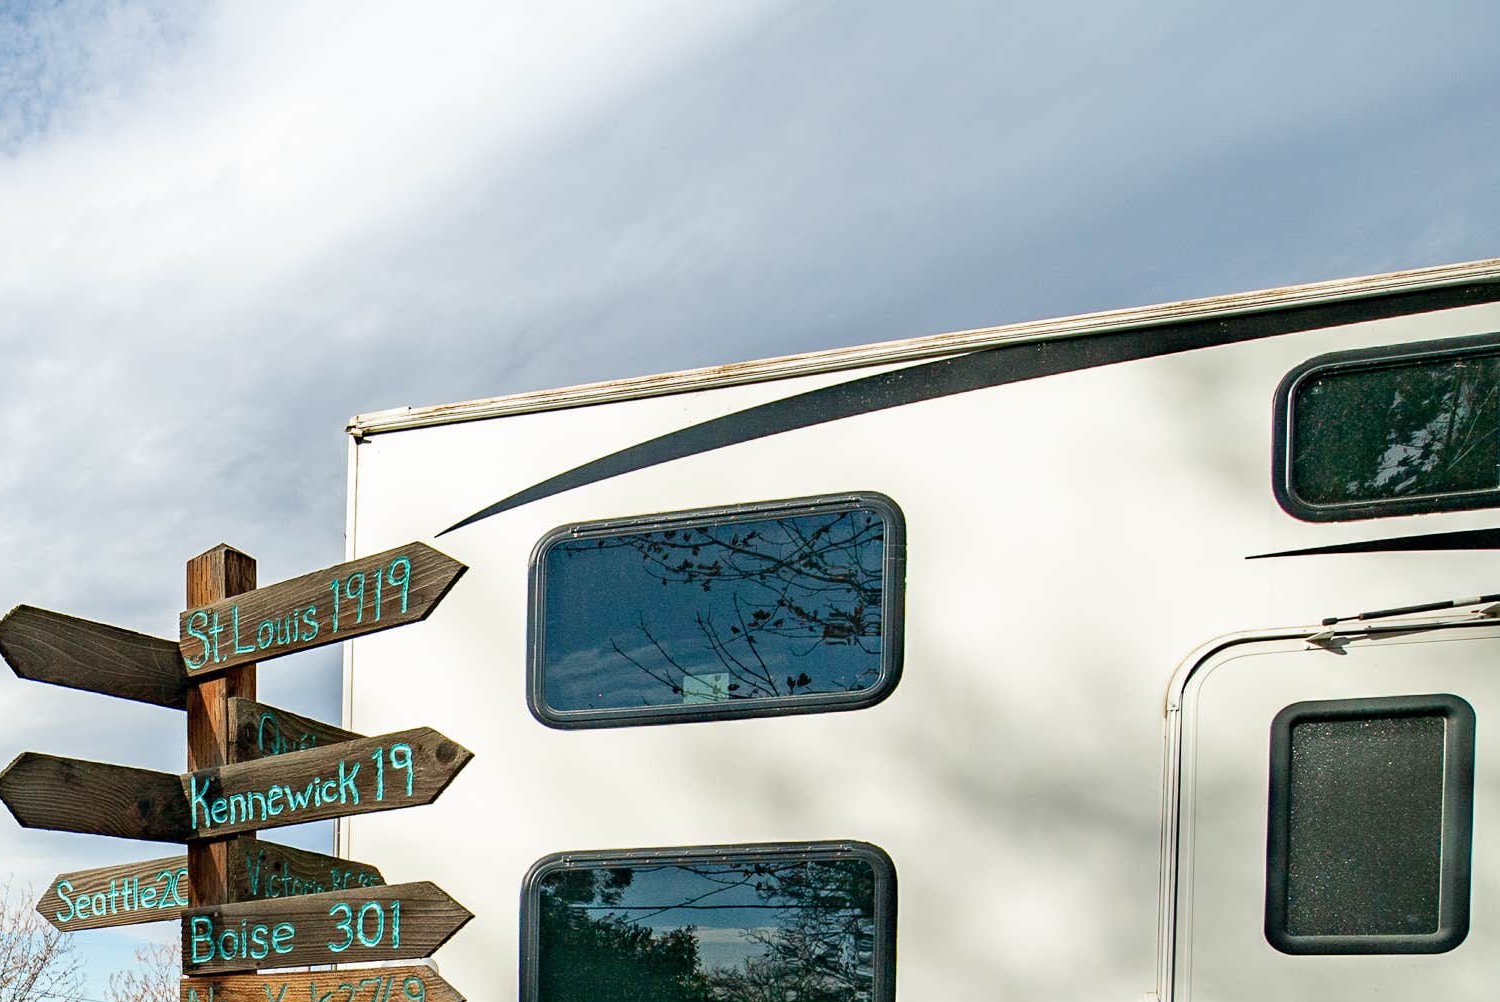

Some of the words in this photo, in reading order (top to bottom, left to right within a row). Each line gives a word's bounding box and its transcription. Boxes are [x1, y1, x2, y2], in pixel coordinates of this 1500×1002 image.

[232, 604, 320, 654] Louis
[329, 555, 412, 634] 1919
[190, 759, 361, 831] Kennewick
[371, 742, 414, 801] 19
[56, 875, 157, 923] Seattle
[190, 914, 296, 964] Boise
[327, 899, 401, 953] 301
